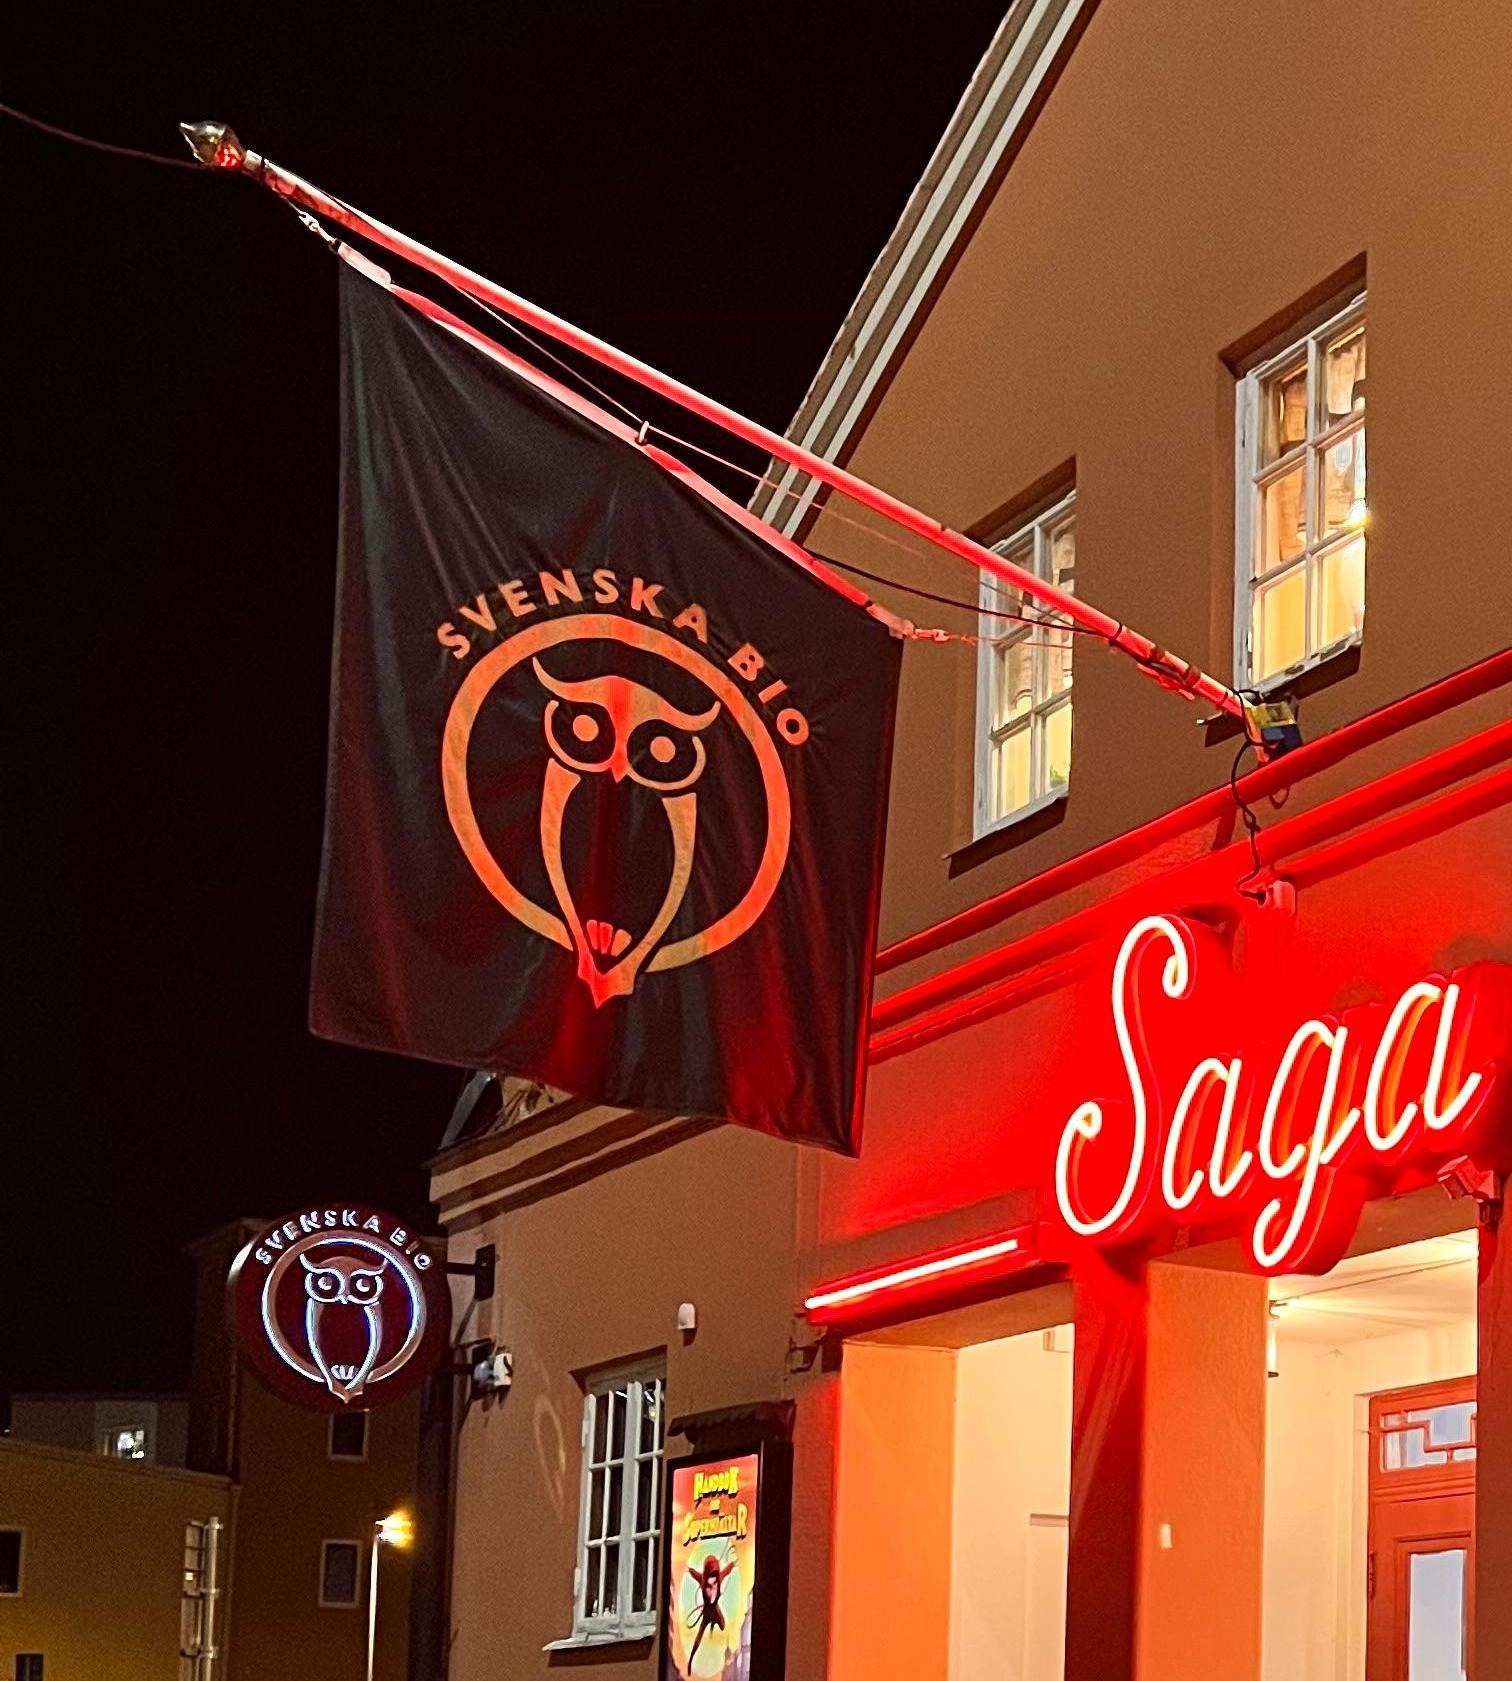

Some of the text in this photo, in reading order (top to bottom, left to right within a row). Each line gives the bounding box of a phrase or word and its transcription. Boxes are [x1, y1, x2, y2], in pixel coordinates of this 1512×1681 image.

[436, 568, 810, 746] SVENSKA BIO
[1055, 915, 1483, 1268] Saga
[255, 1209, 433, 1270] SVENSKA BIO
